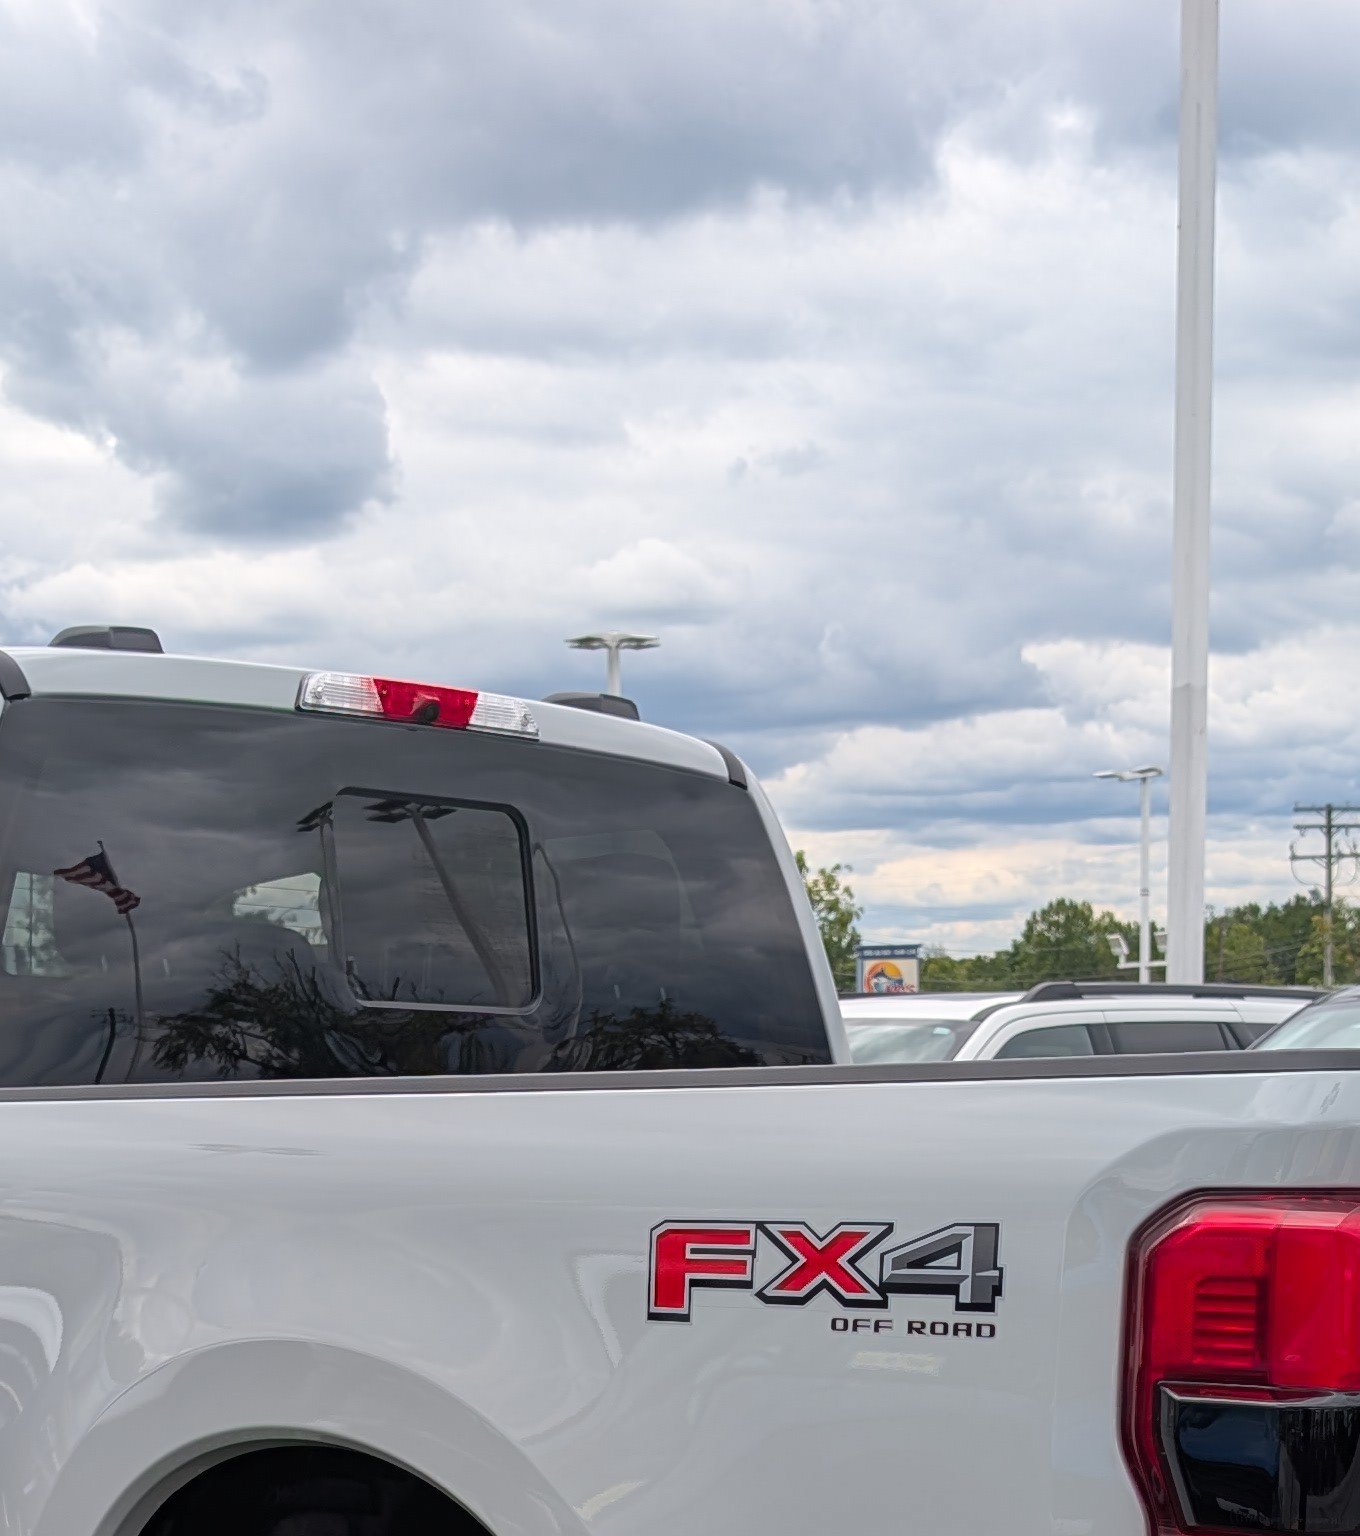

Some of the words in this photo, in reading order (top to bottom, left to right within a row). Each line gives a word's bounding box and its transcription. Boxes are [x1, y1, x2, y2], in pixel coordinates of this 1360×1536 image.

[648, 1218, 1003, 1322] FX4
[830, 1317, 894, 1333] OFF
[906, 1320, 997, 1339] ROAD
